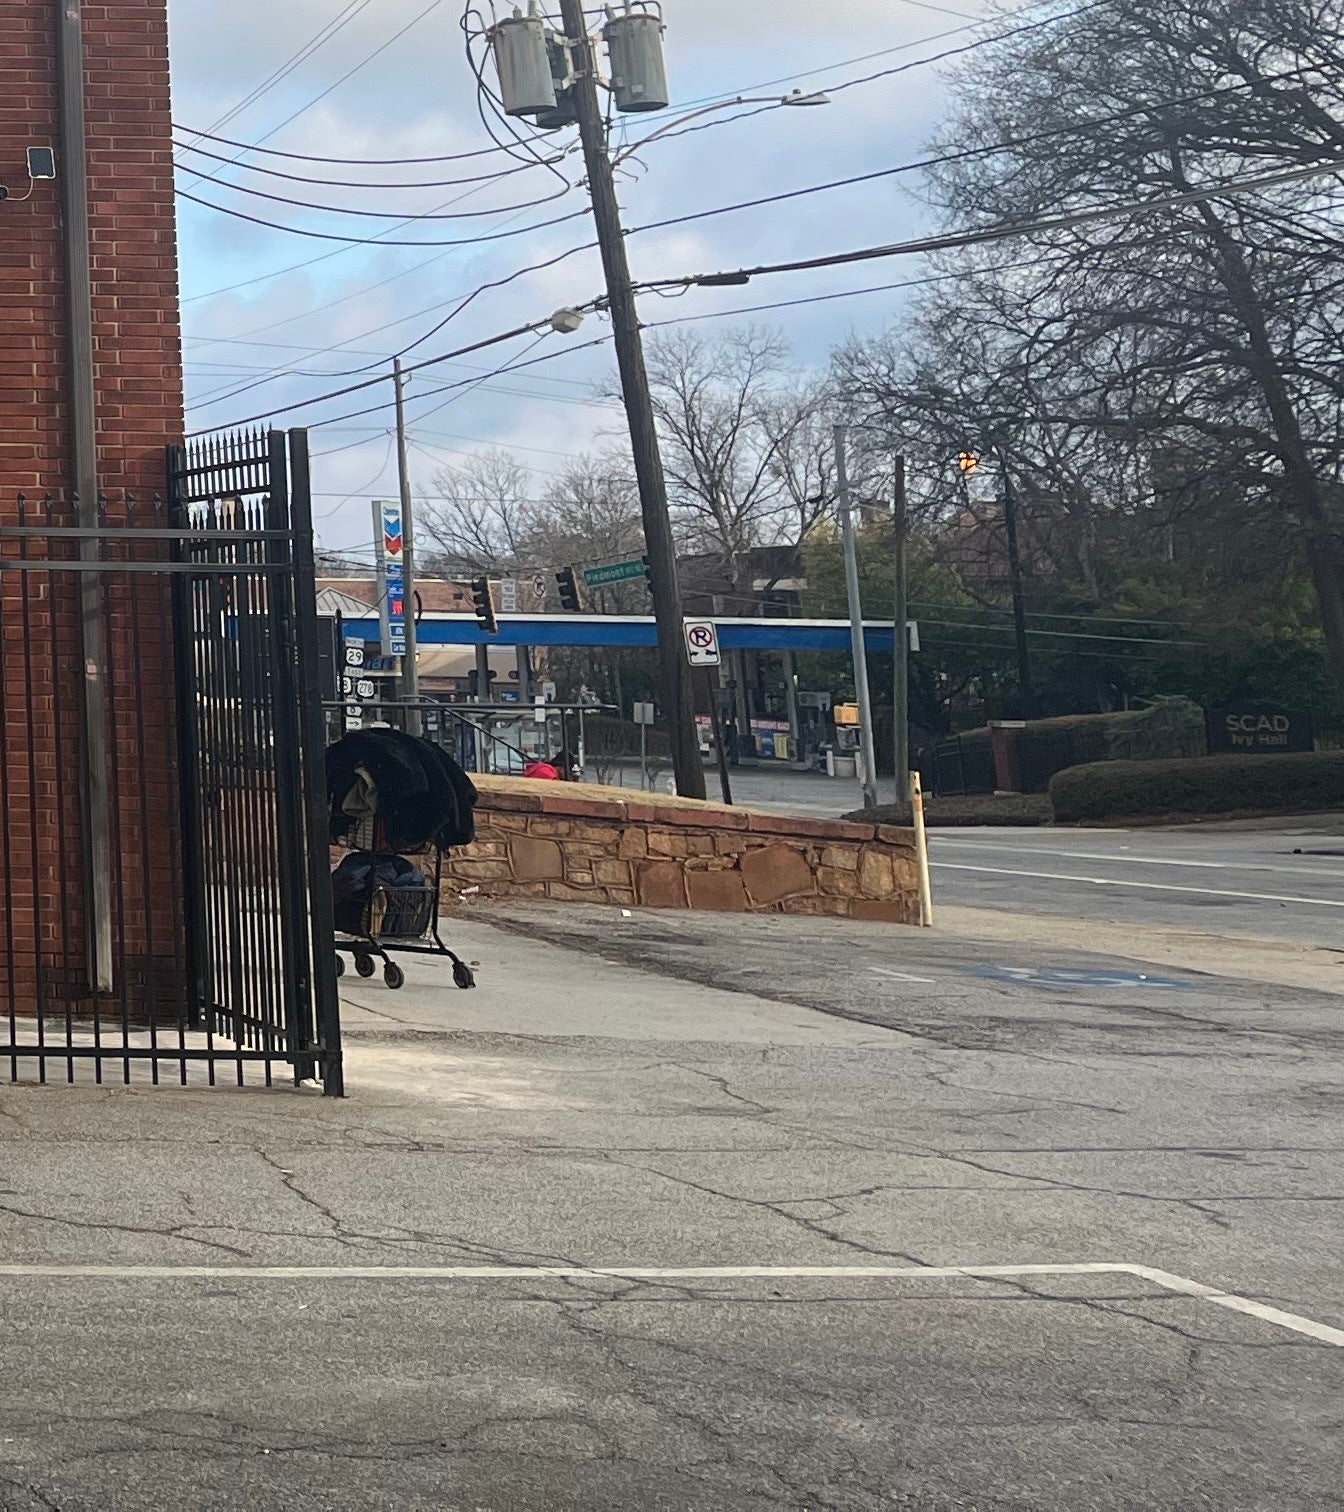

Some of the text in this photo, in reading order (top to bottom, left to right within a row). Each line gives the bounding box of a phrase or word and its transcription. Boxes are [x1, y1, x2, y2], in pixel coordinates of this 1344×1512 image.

[348, 650, 362, 662] 29
[359, 682, 373, 694] 278
[1225, 714, 1290, 732] SCAD
[1232, 734, 1288, 746] Ivy Hall
